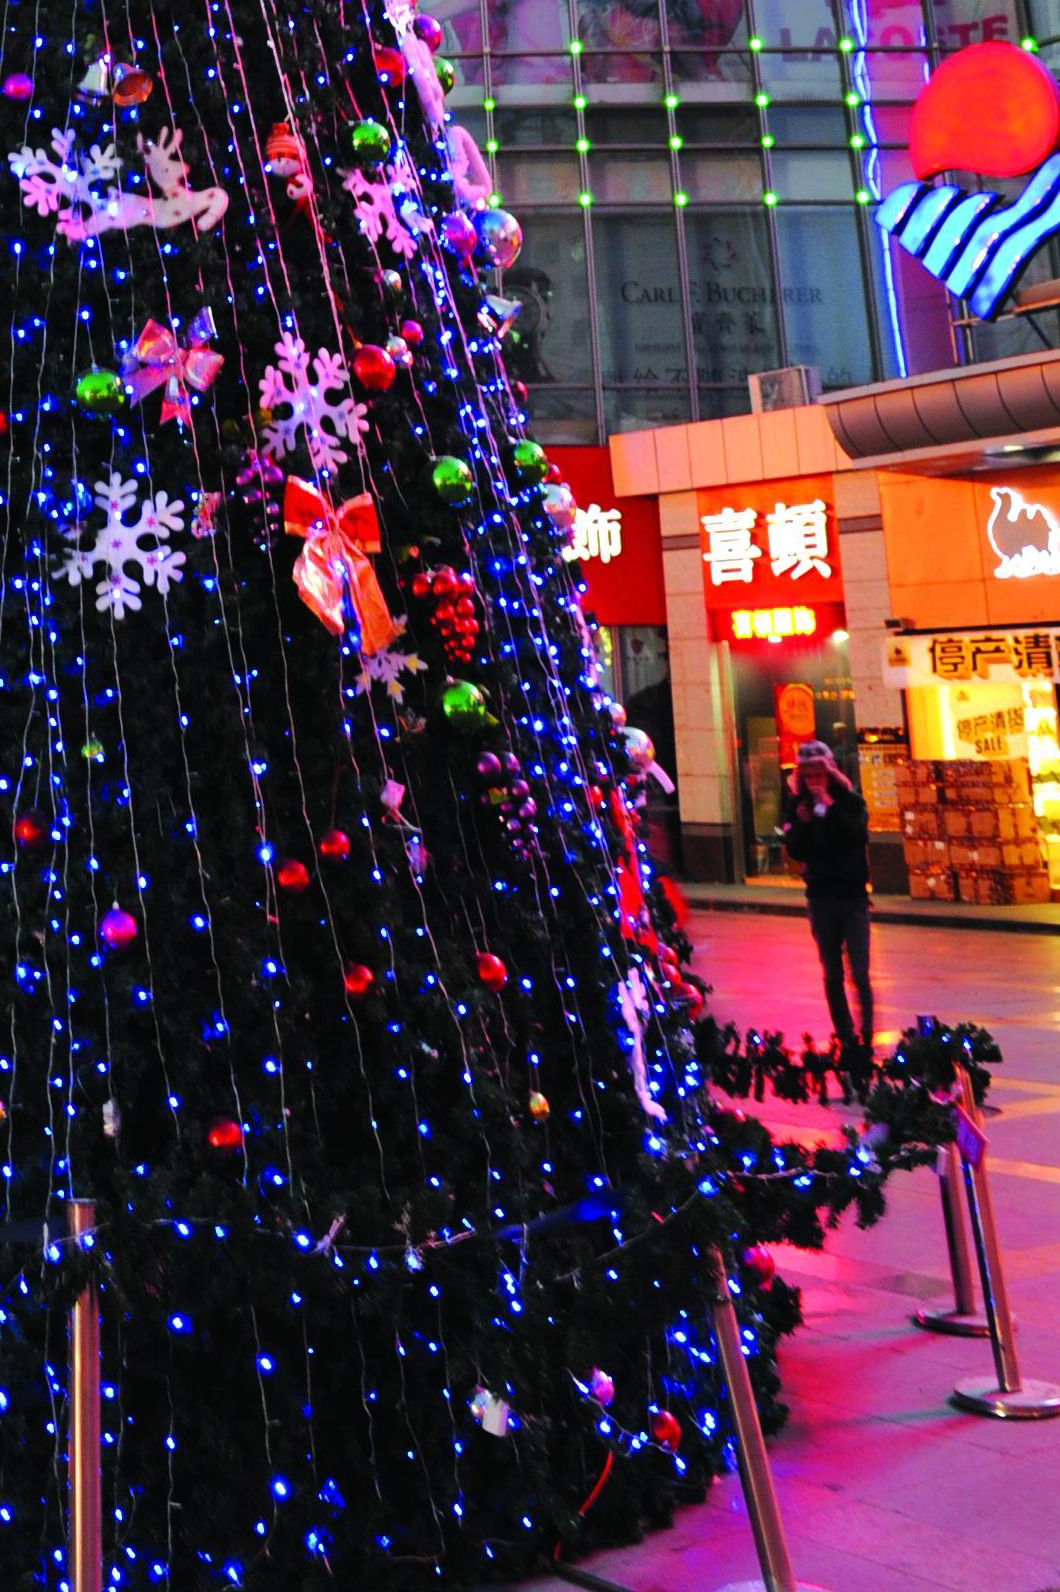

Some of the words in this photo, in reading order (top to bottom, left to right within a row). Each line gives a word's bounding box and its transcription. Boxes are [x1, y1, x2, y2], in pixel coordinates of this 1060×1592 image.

[779, 14, 1010, 62] LAOTE
[929, 632, 1060, 674] 停产清
[975, 736, 1002, 754] SALE
